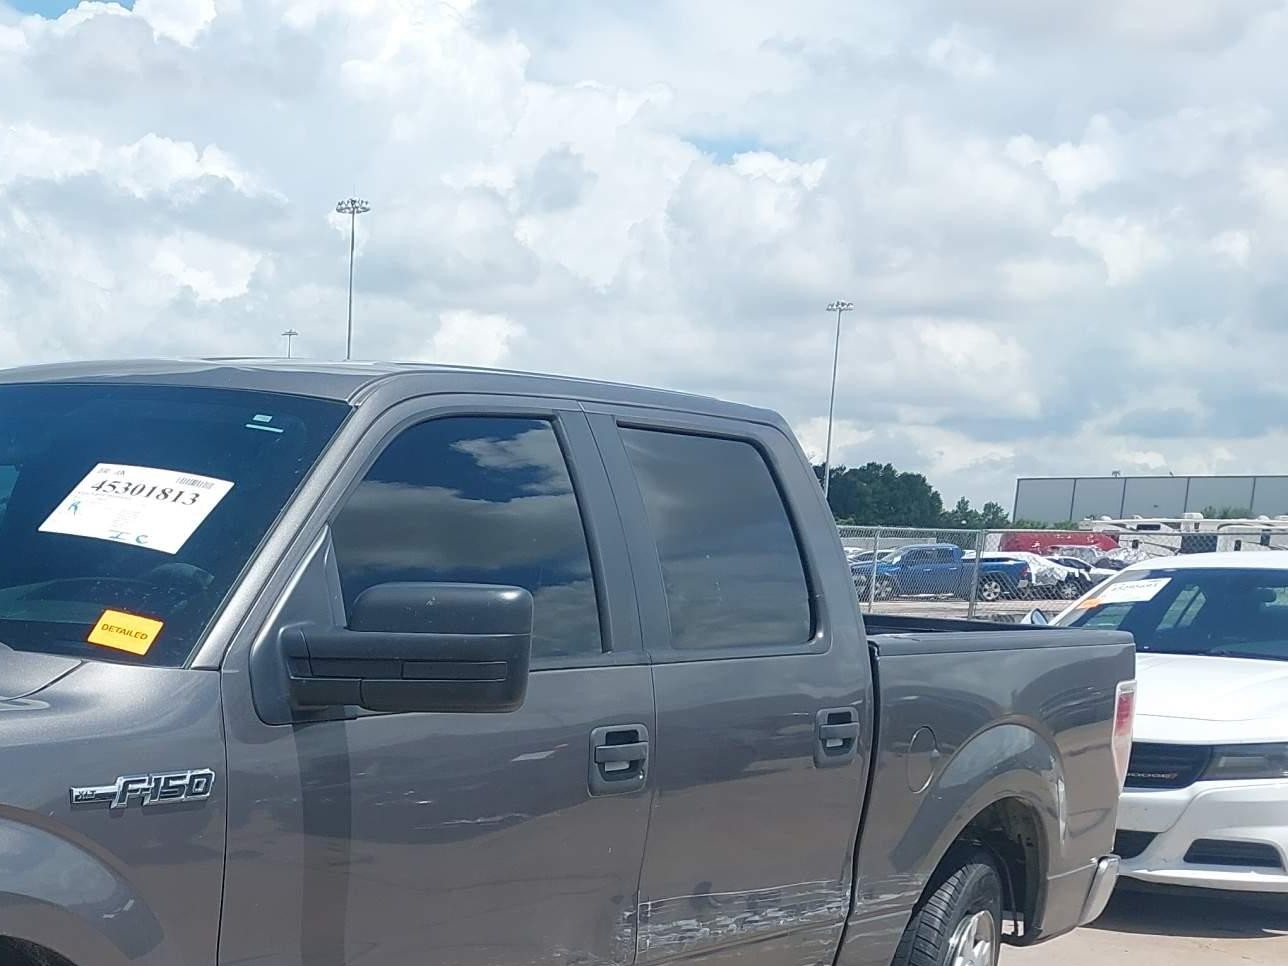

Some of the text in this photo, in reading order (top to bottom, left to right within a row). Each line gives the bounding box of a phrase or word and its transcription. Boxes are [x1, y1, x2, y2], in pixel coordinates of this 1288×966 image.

[90, 479, 200, 506] 45301813
[101, 623, 148, 640] DETAILED
[76, 790, 96, 800] XLT
